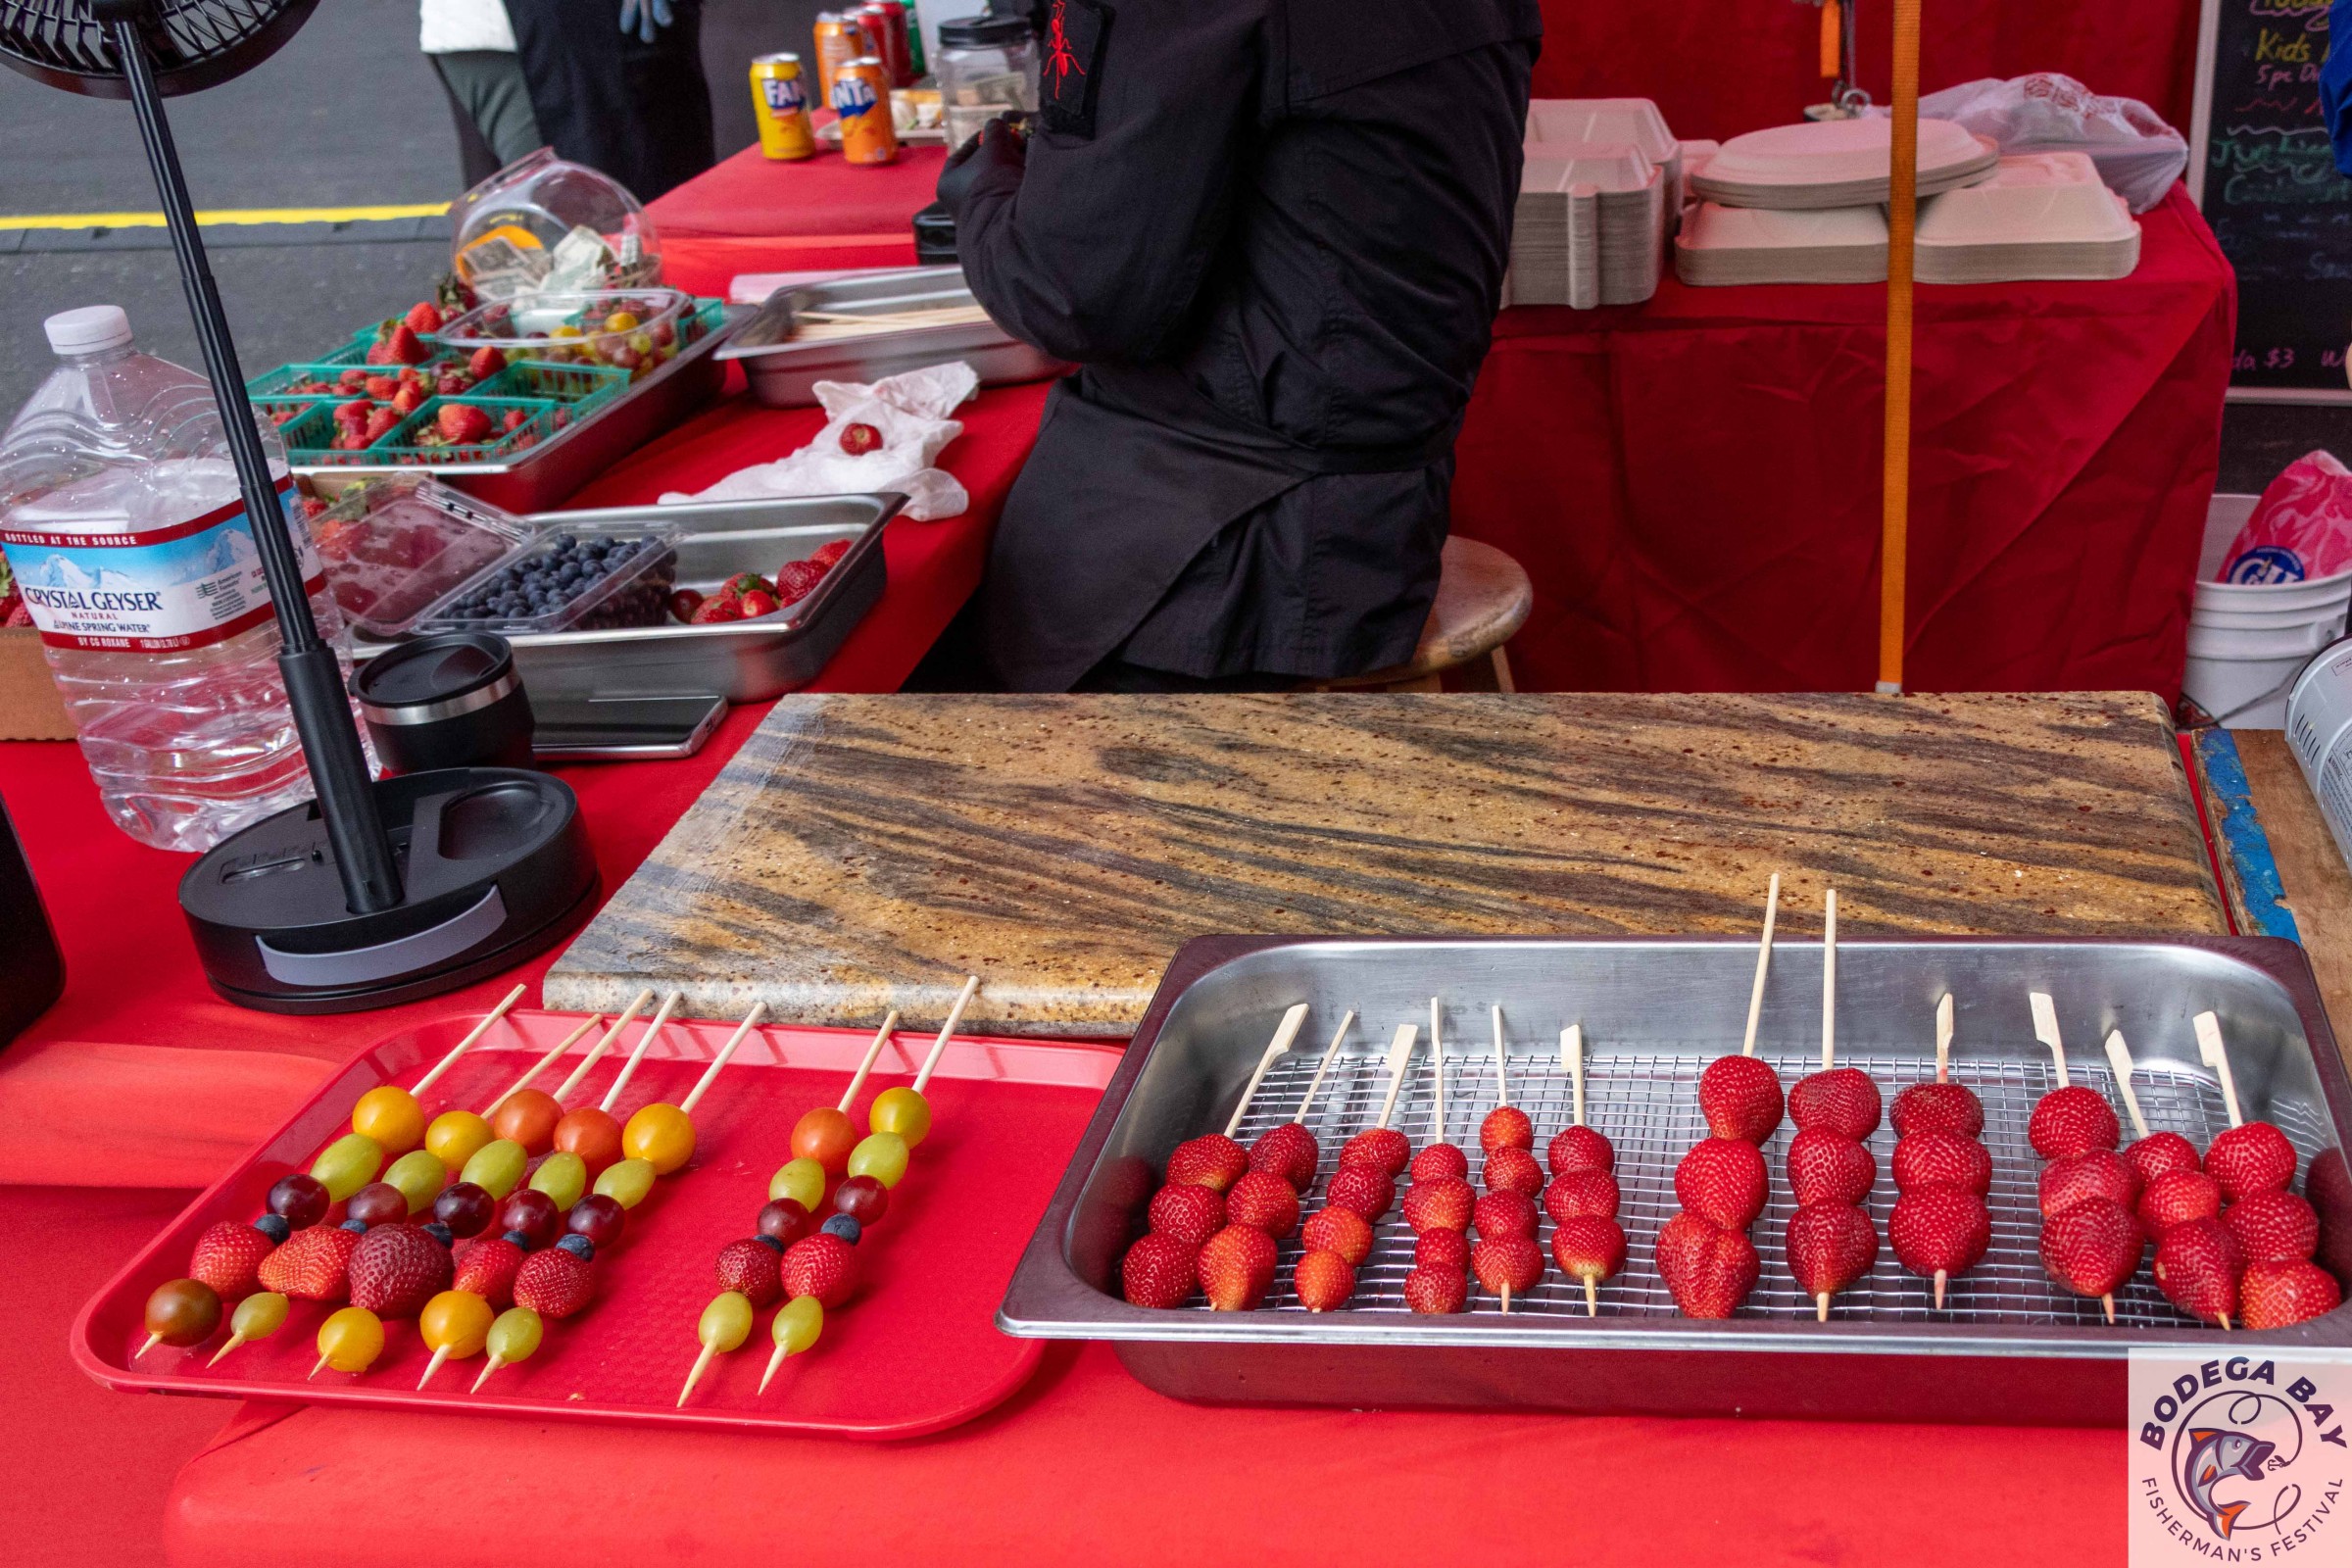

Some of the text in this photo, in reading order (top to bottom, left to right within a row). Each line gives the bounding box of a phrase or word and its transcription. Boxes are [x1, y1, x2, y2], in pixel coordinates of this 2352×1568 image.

[2254, 26, 2311, 63] Kids
[2263, 347, 2296, 369] $3
[5, 532, 46, 544] BOTTLED
[67, 536, 87, 546] THE
[91, 535, 138, 546] SOURCE
[24, 587, 164, 612] CRYSTAL GEYSER
[71, 612, 119, 620] NATURAL
[53, 619, 149, 634] ALPINE SPRING WATER
[77, 637, 88, 647] BY
[100, 638, 131, 648] ROXANE
